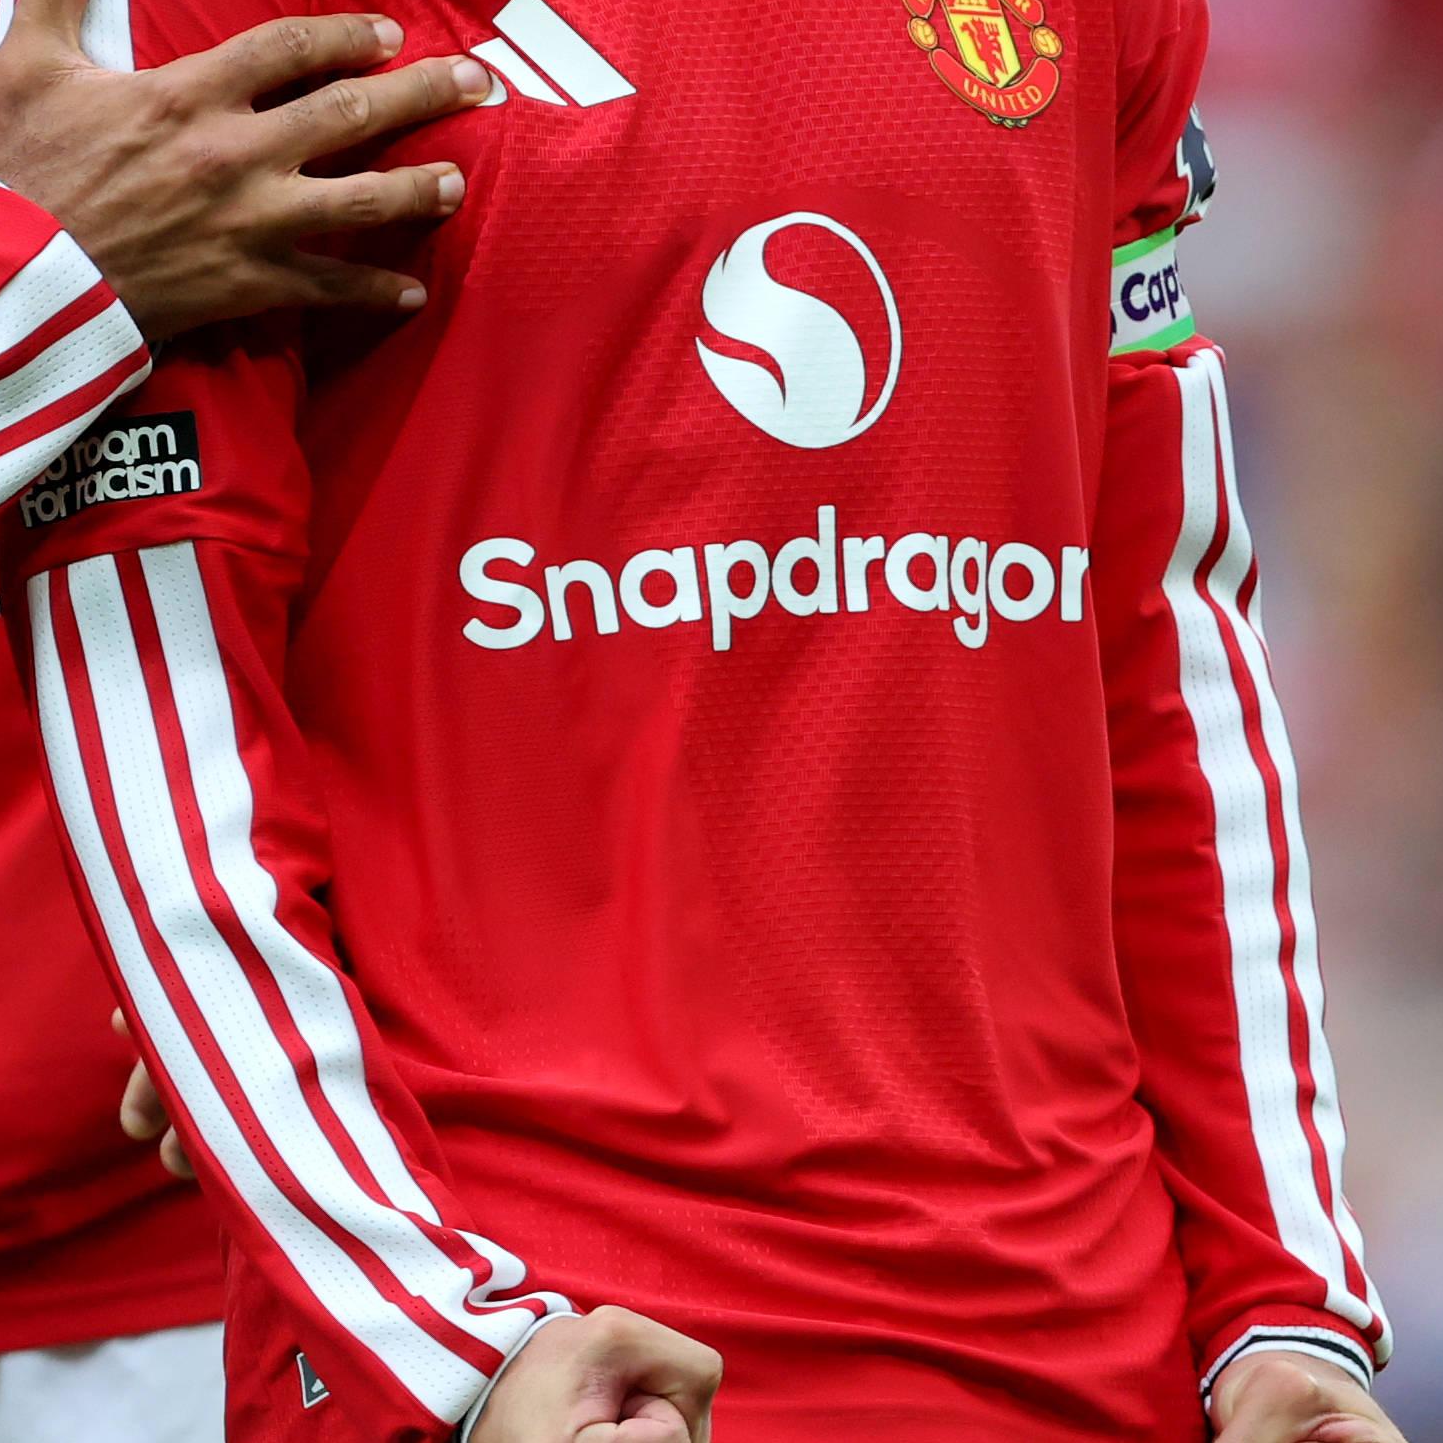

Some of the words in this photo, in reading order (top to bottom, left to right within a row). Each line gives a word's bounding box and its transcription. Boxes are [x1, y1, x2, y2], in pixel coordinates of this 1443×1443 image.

[963, 78, 1043, 112] UNITED
[1120, 258, 1182, 322] Cap
[72, 423, 177, 473] room
[75, 458, 201, 511] racism
